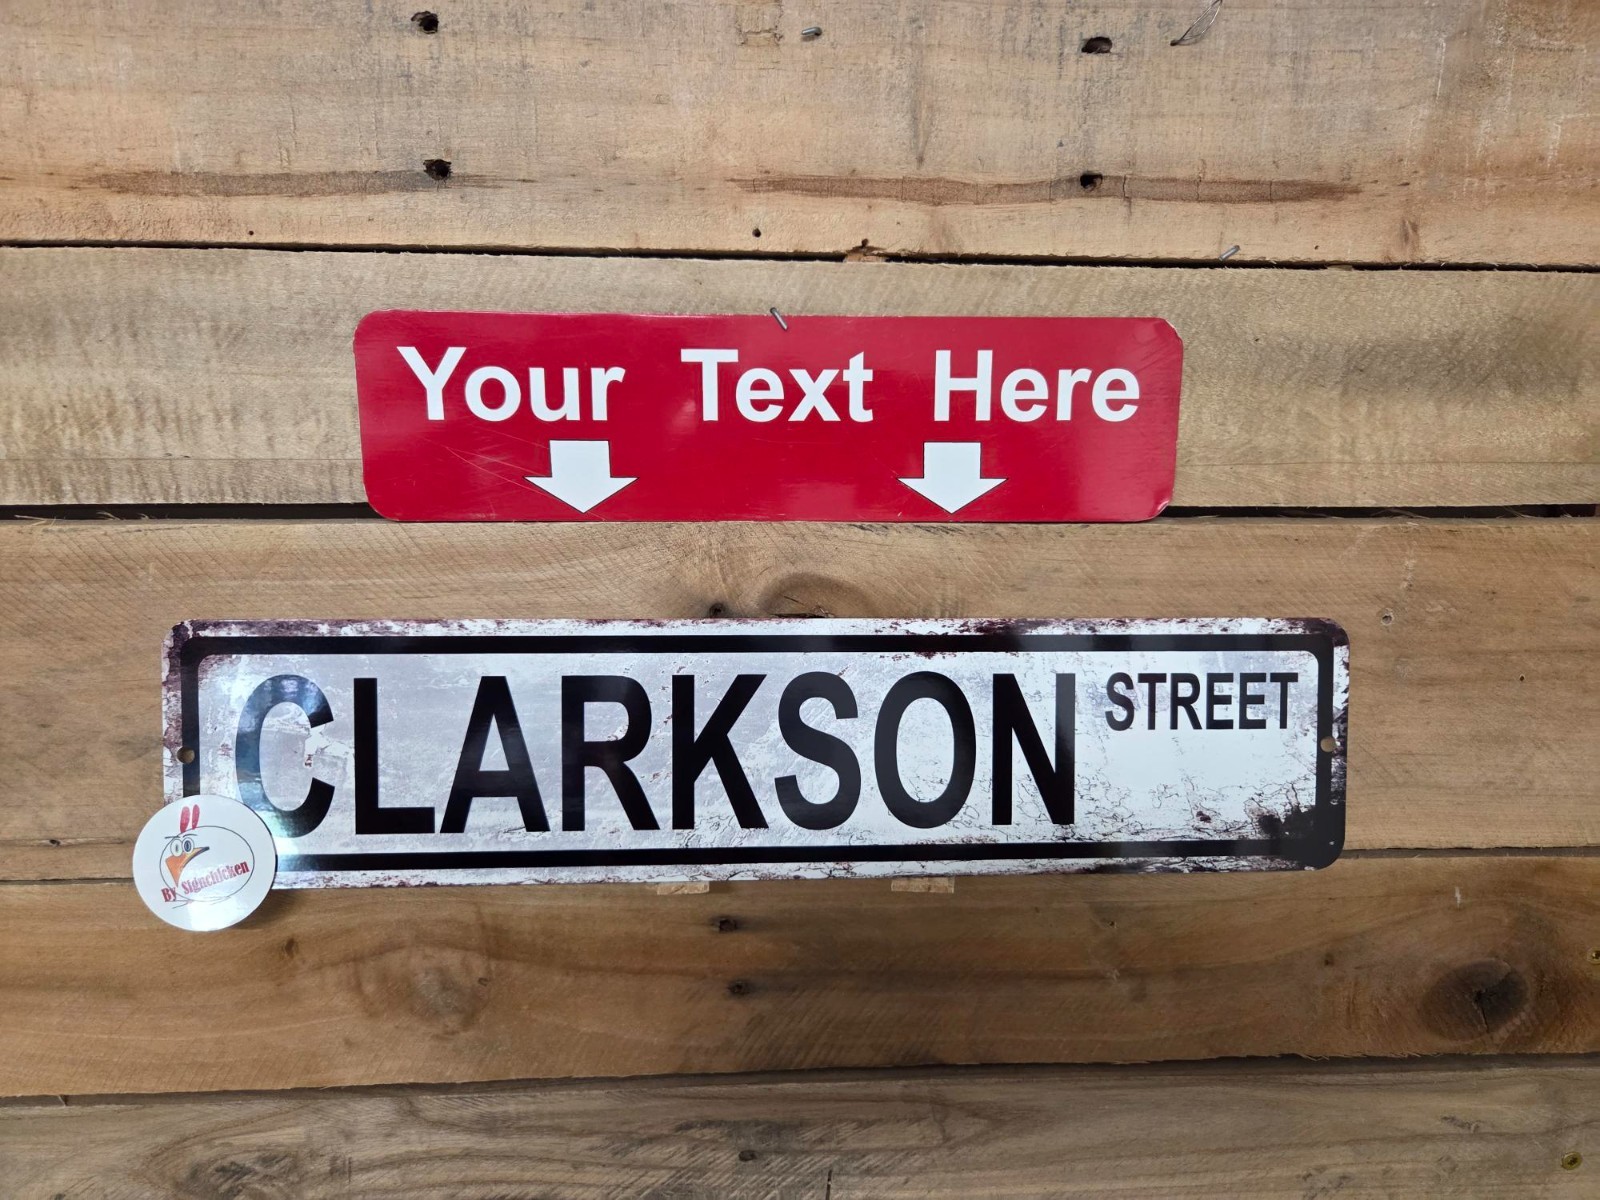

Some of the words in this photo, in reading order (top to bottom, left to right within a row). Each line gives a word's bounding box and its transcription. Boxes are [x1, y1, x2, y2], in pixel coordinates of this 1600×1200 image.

[397, 346, 625, 421] Your
[681, 348, 873, 423] Text
[934, 350, 1140, 423] Here
[236, 672, 1075, 837] CLARKSON
[1107, 673, 1298, 731] STREET
[161, 886, 177, 902] By
